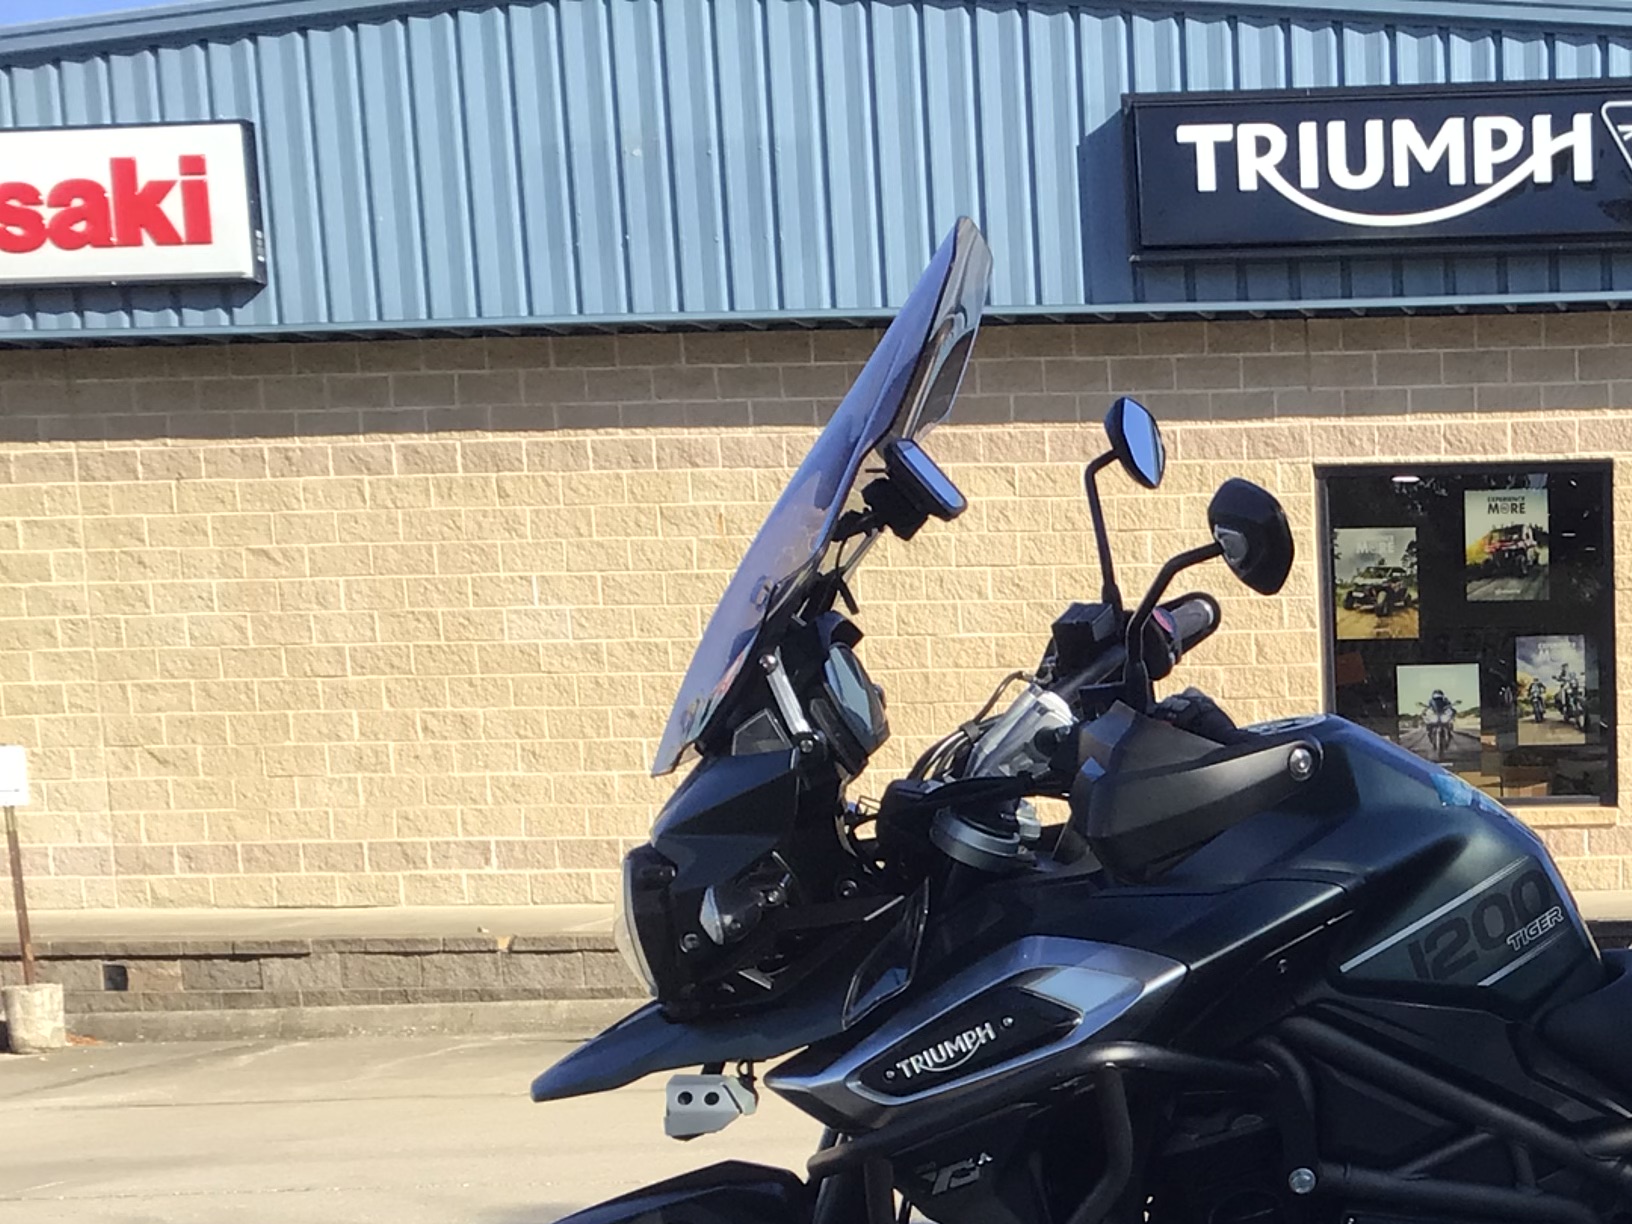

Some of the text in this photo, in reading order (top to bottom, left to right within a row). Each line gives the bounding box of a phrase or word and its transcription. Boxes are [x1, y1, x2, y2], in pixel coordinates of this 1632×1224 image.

[1176, 113, 1593, 227] TRIUMPH
[1487, 503, 1526, 514] MORE
[1408, 869, 1554, 982] 1200
[1506, 905, 1564, 952] TIGER
[896, 1022, 996, 1080] TRIUMPH
